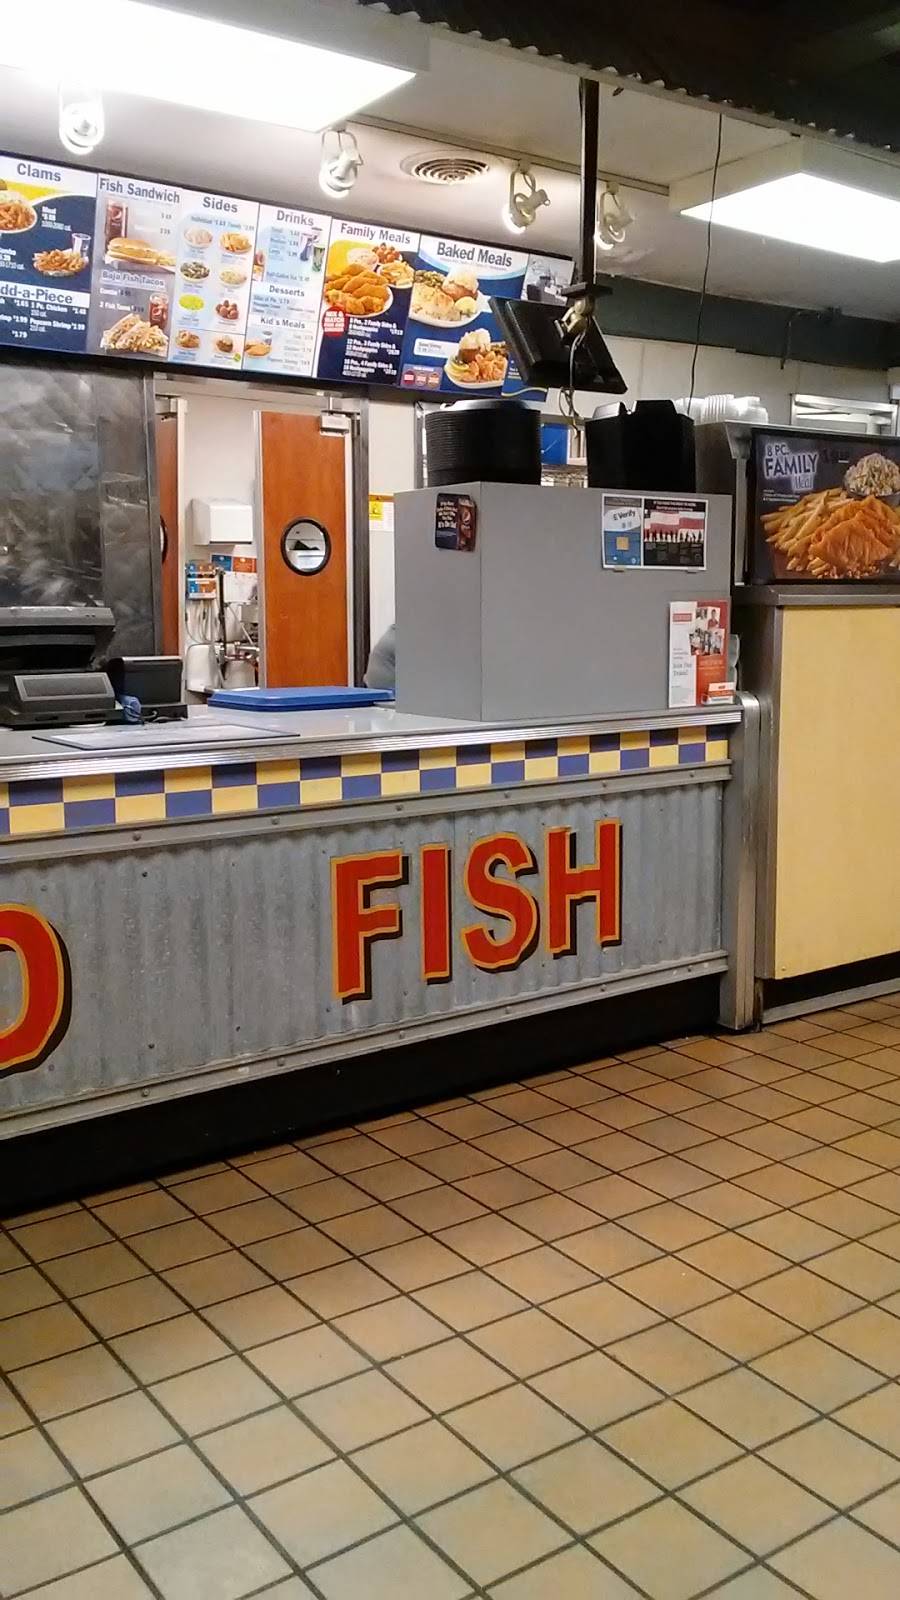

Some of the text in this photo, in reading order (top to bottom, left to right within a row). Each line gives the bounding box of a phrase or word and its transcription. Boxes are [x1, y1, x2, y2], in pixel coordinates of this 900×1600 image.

[17, 163, 62, 182] Clams
[99, 178, 180, 204] Fish Sandwich
[203, 196, 238, 213] Sides
[276, 210, 314, 227] Drinks
[340, 223, 411, 245] Family Meals
[436, 241, 474, 261] Baked
[477, 249, 513, 268] Meals
[102, 270, 121, 281] Baja
[141, 276, 165, 286] Tacos
[0, 284, 73, 304] dd-a-Piece
[269, 285, 305, 297] Desserts
[282, 319, 306, 329] Meals
[766, 445, 773, 457] 8
[765, 453, 818, 477] FAMILY
[331, 816, 622, 1005] FISH
